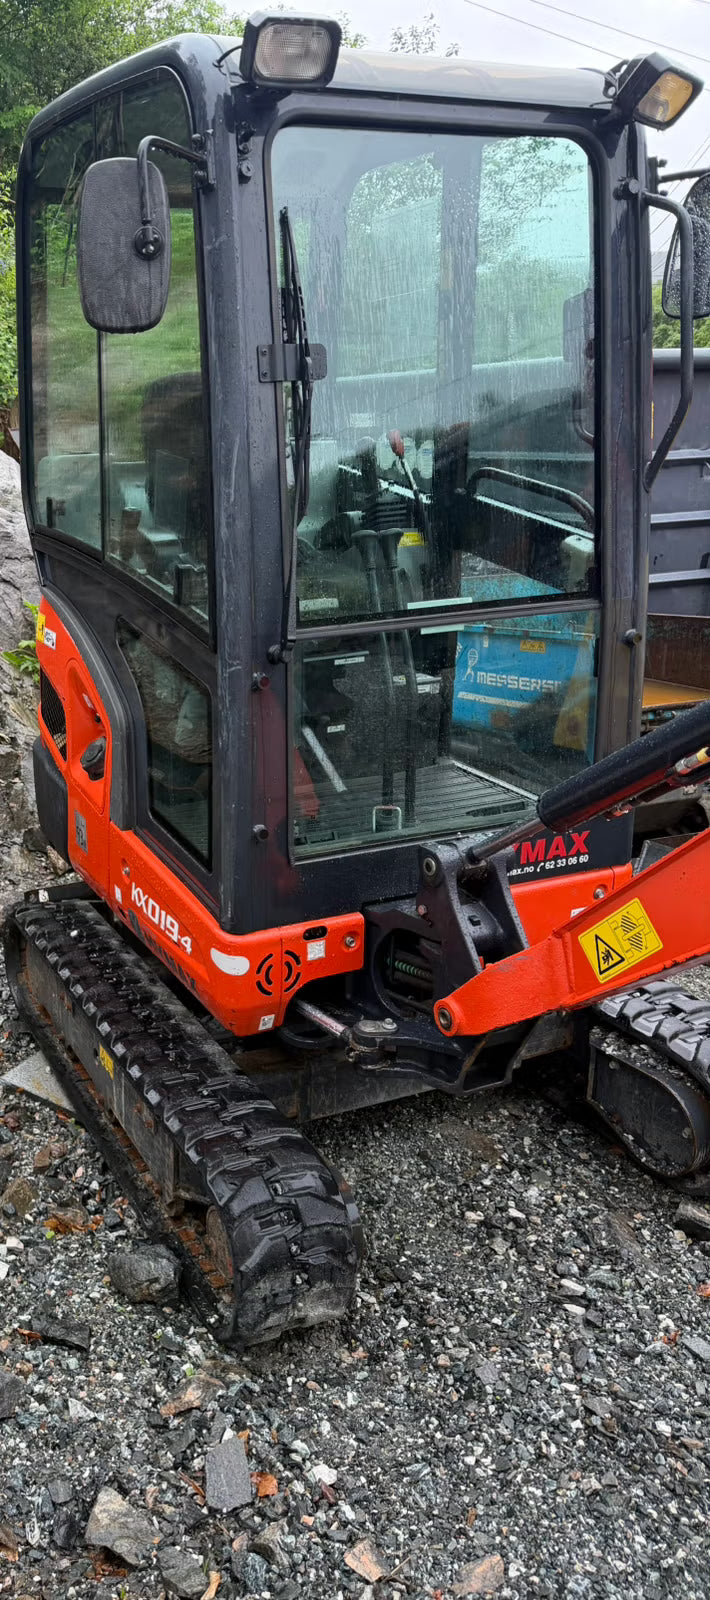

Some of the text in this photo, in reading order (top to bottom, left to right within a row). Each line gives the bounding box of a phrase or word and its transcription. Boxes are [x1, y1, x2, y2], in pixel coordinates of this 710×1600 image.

[545, 860, 555, 870] 62
[556, 858, 567, 868] 33
[567, 856, 578, 866] 06
[578, 854, 589, 864] 60
